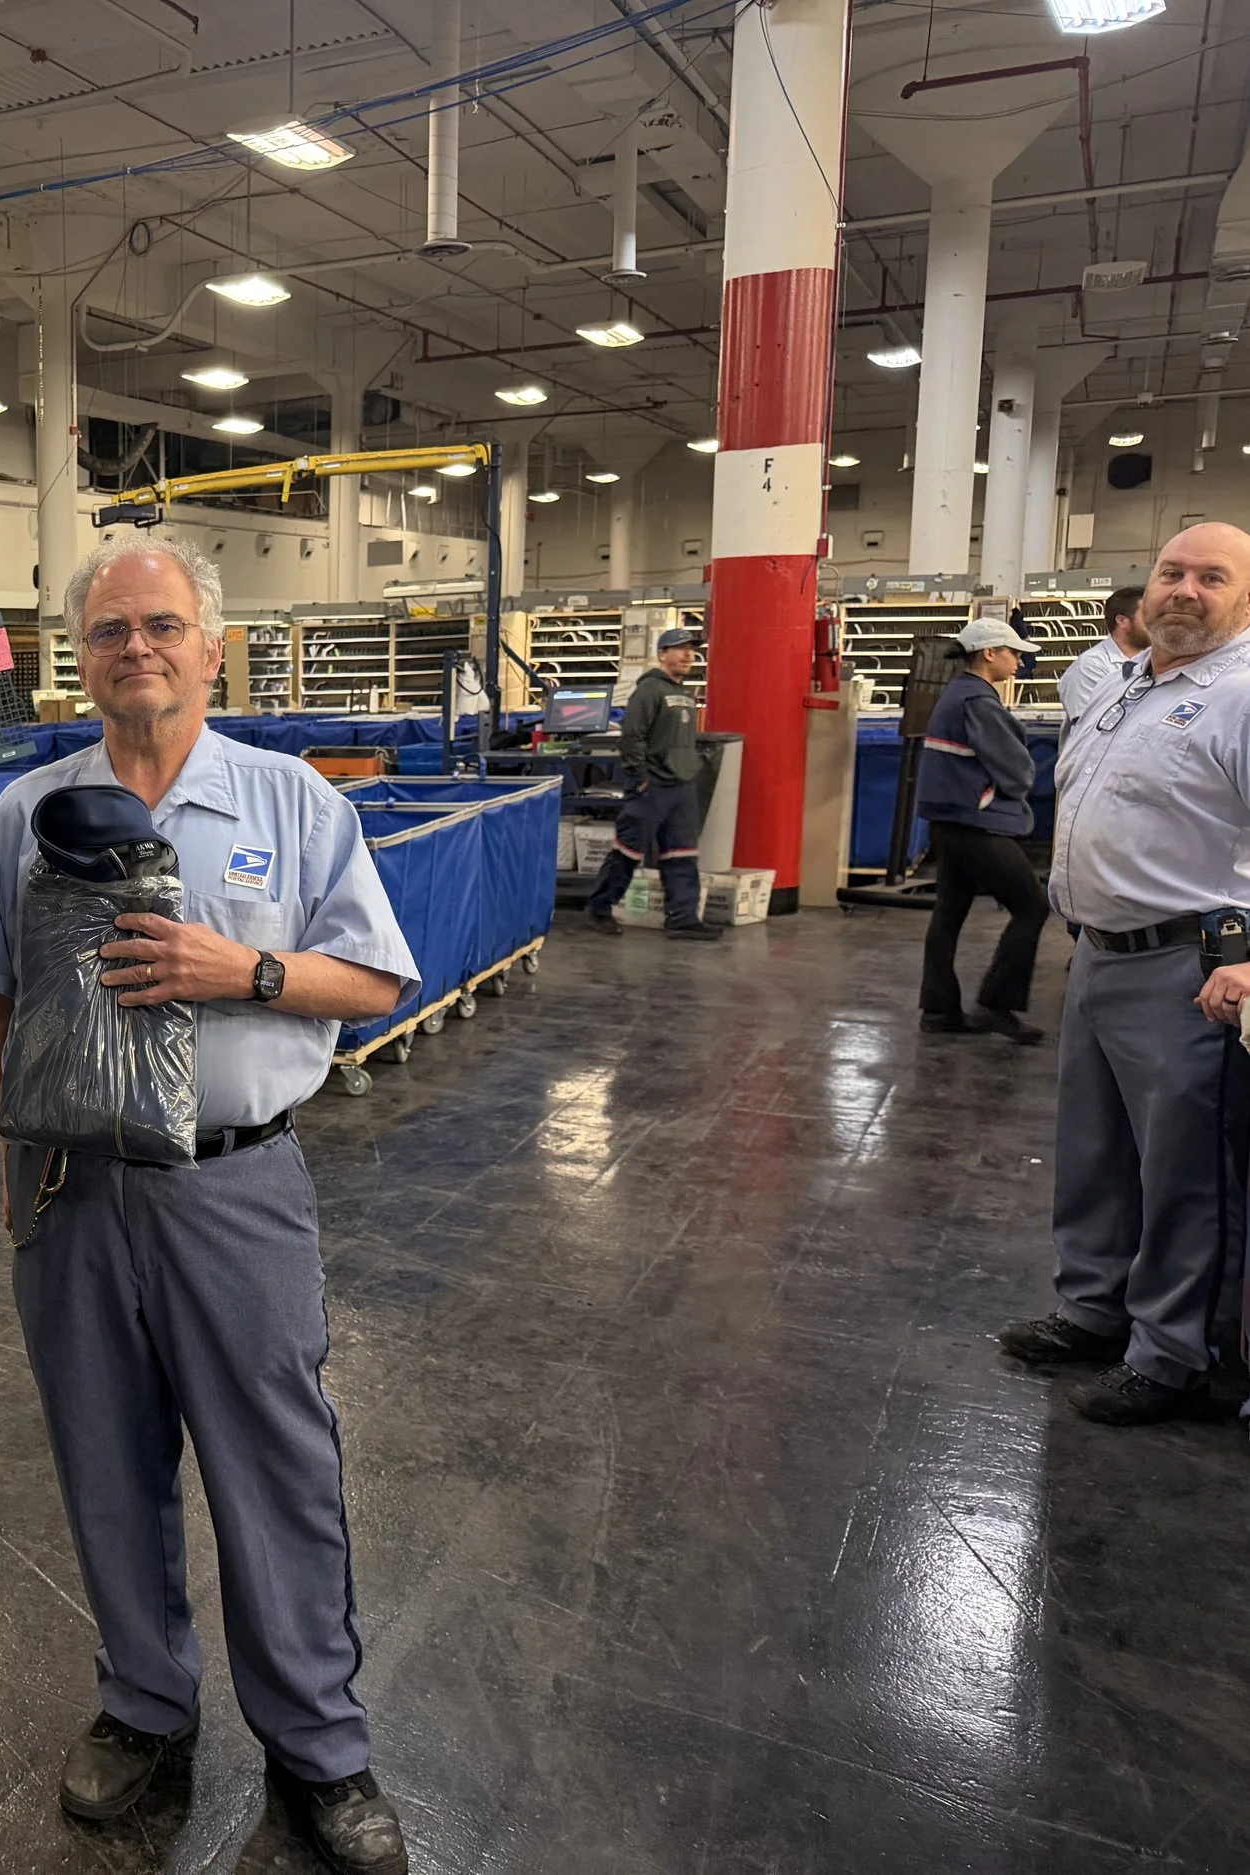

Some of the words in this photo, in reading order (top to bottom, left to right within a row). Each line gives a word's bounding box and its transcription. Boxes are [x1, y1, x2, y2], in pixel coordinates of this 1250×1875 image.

[764, 458, 774, 473] F
[762, 477, 771, 492] 4
[228, 871, 246, 880] UNITED
[245, 879, 263, 887] SERVICE
